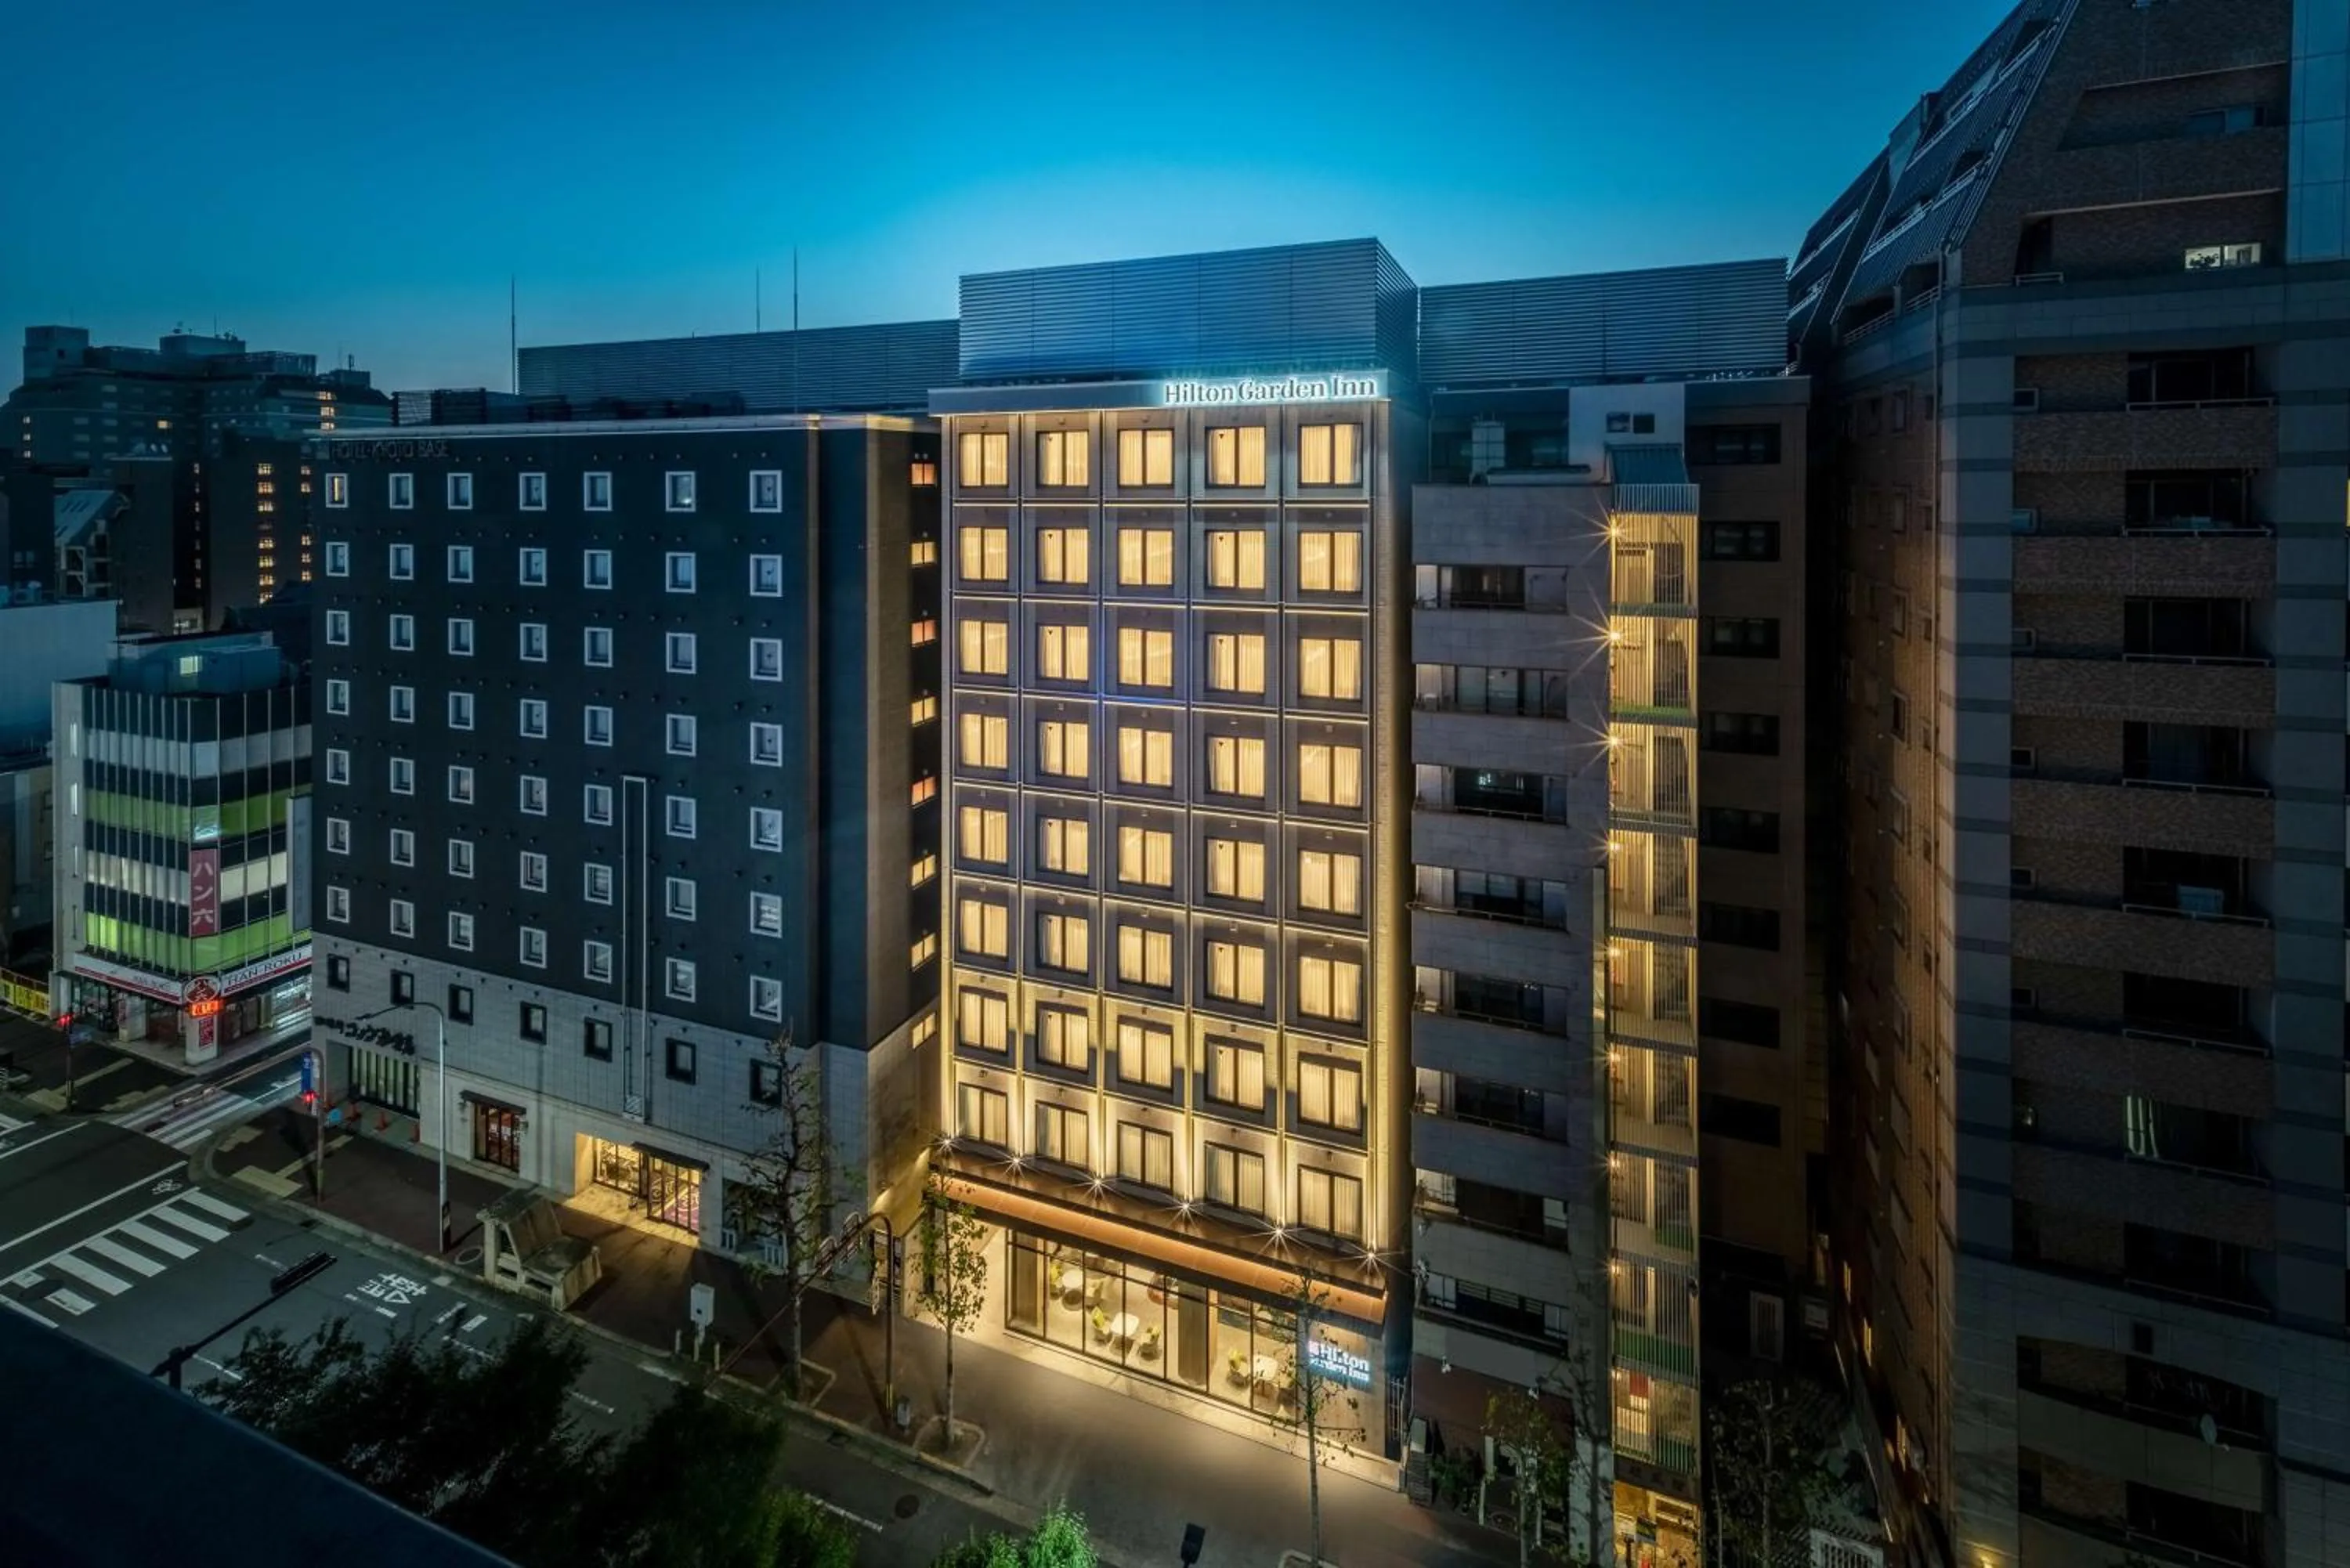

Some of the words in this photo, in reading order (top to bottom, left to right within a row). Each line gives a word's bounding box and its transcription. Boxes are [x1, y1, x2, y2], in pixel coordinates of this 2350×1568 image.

[1164, 381, 1235, 404] Hilton
[1238, 378, 1325, 402] Garden
[1332, 375, 1376, 398] Inn
[192, 862, 214, 925] ハン六
